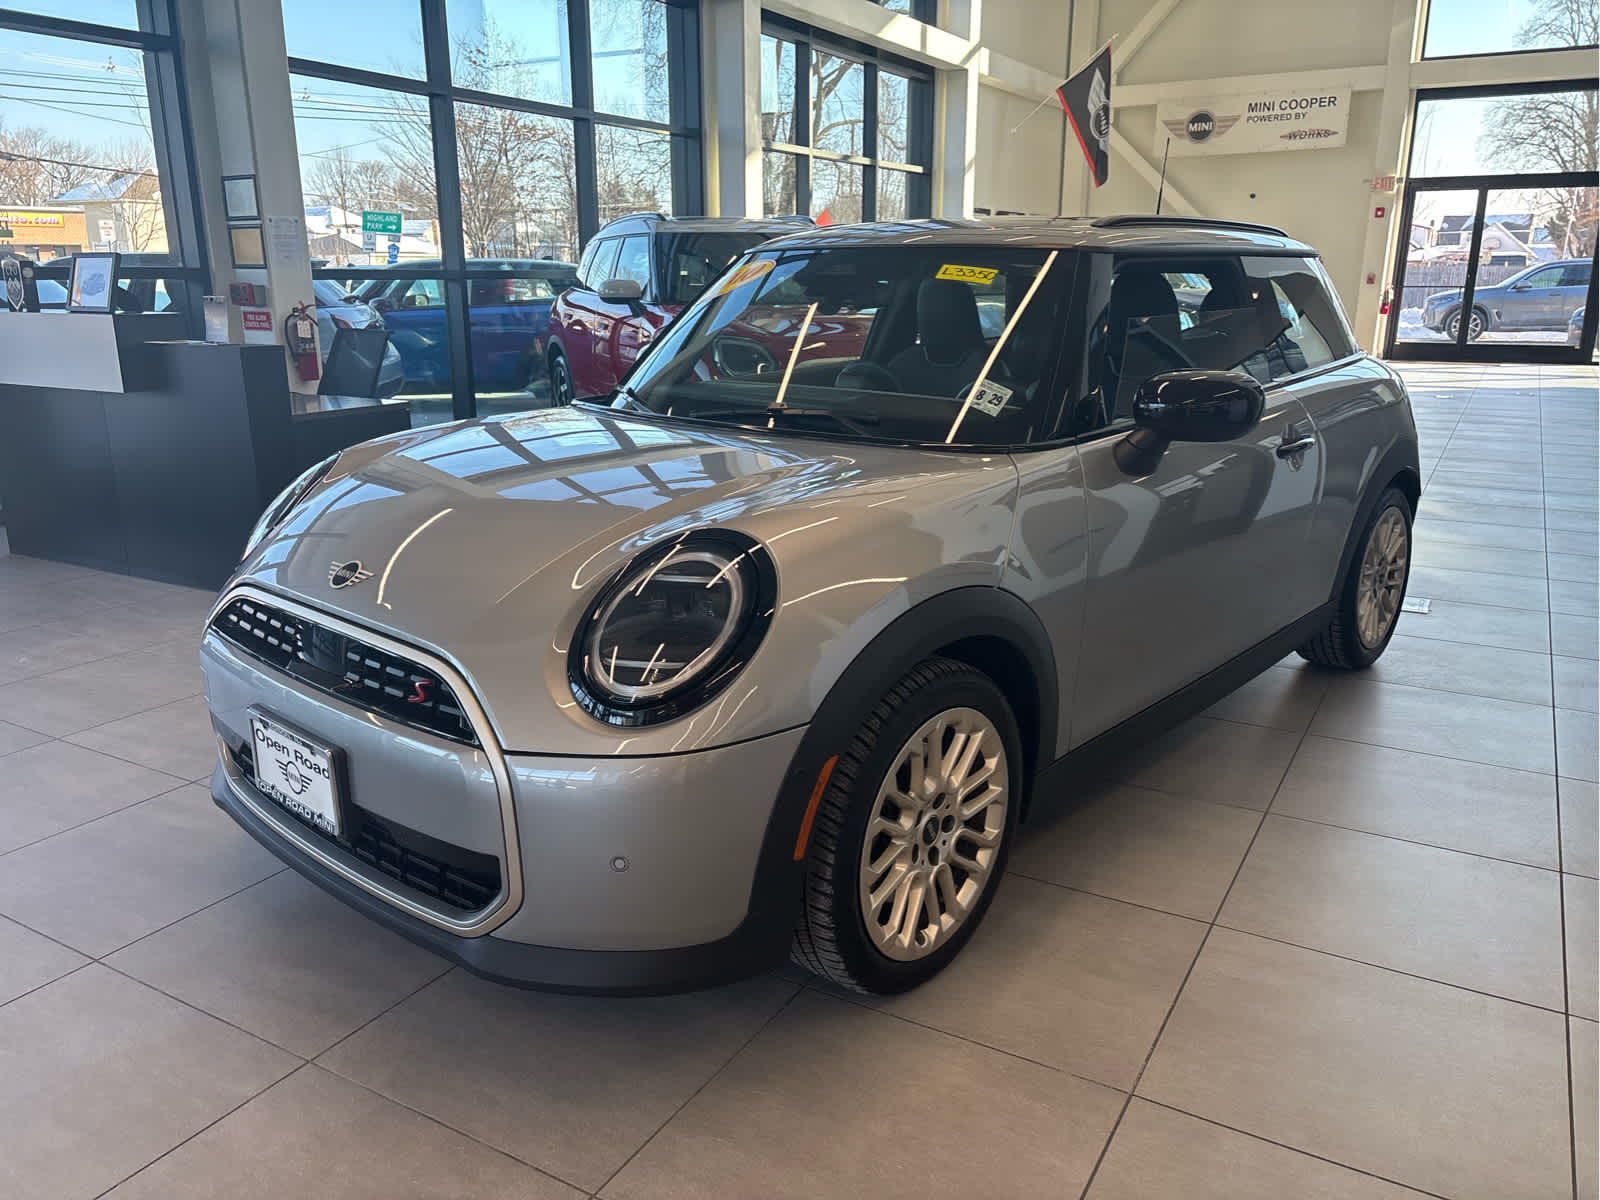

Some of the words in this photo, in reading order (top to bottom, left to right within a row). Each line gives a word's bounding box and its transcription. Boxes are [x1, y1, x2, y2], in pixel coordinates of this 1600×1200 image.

[1247, 102, 1275, 113] MINI
[1279, 96, 1337, 111] COOPER
[1246, 113, 1292, 124] POWERED
[1295, 111, 1308, 121] BY
[1188, 121, 1213, 132] MINI
[1287, 129, 1332, 141] WORKS
[1, 213, 60, 225] uto.com
[366, 213, 398, 223] HIGHLAND
[366, 222, 383, 230] PARK
[976, 390, 986, 401] 8
[988, 393, 1004, 406] 29
[407, 680, 432, 703] S
[255, 728, 290, 757] Open
[294, 749, 330, 780] Road
[260, 782, 284, 804] OPEN
[286, 797, 313, 819] ROAD
[314, 813, 335, 833] MINI
